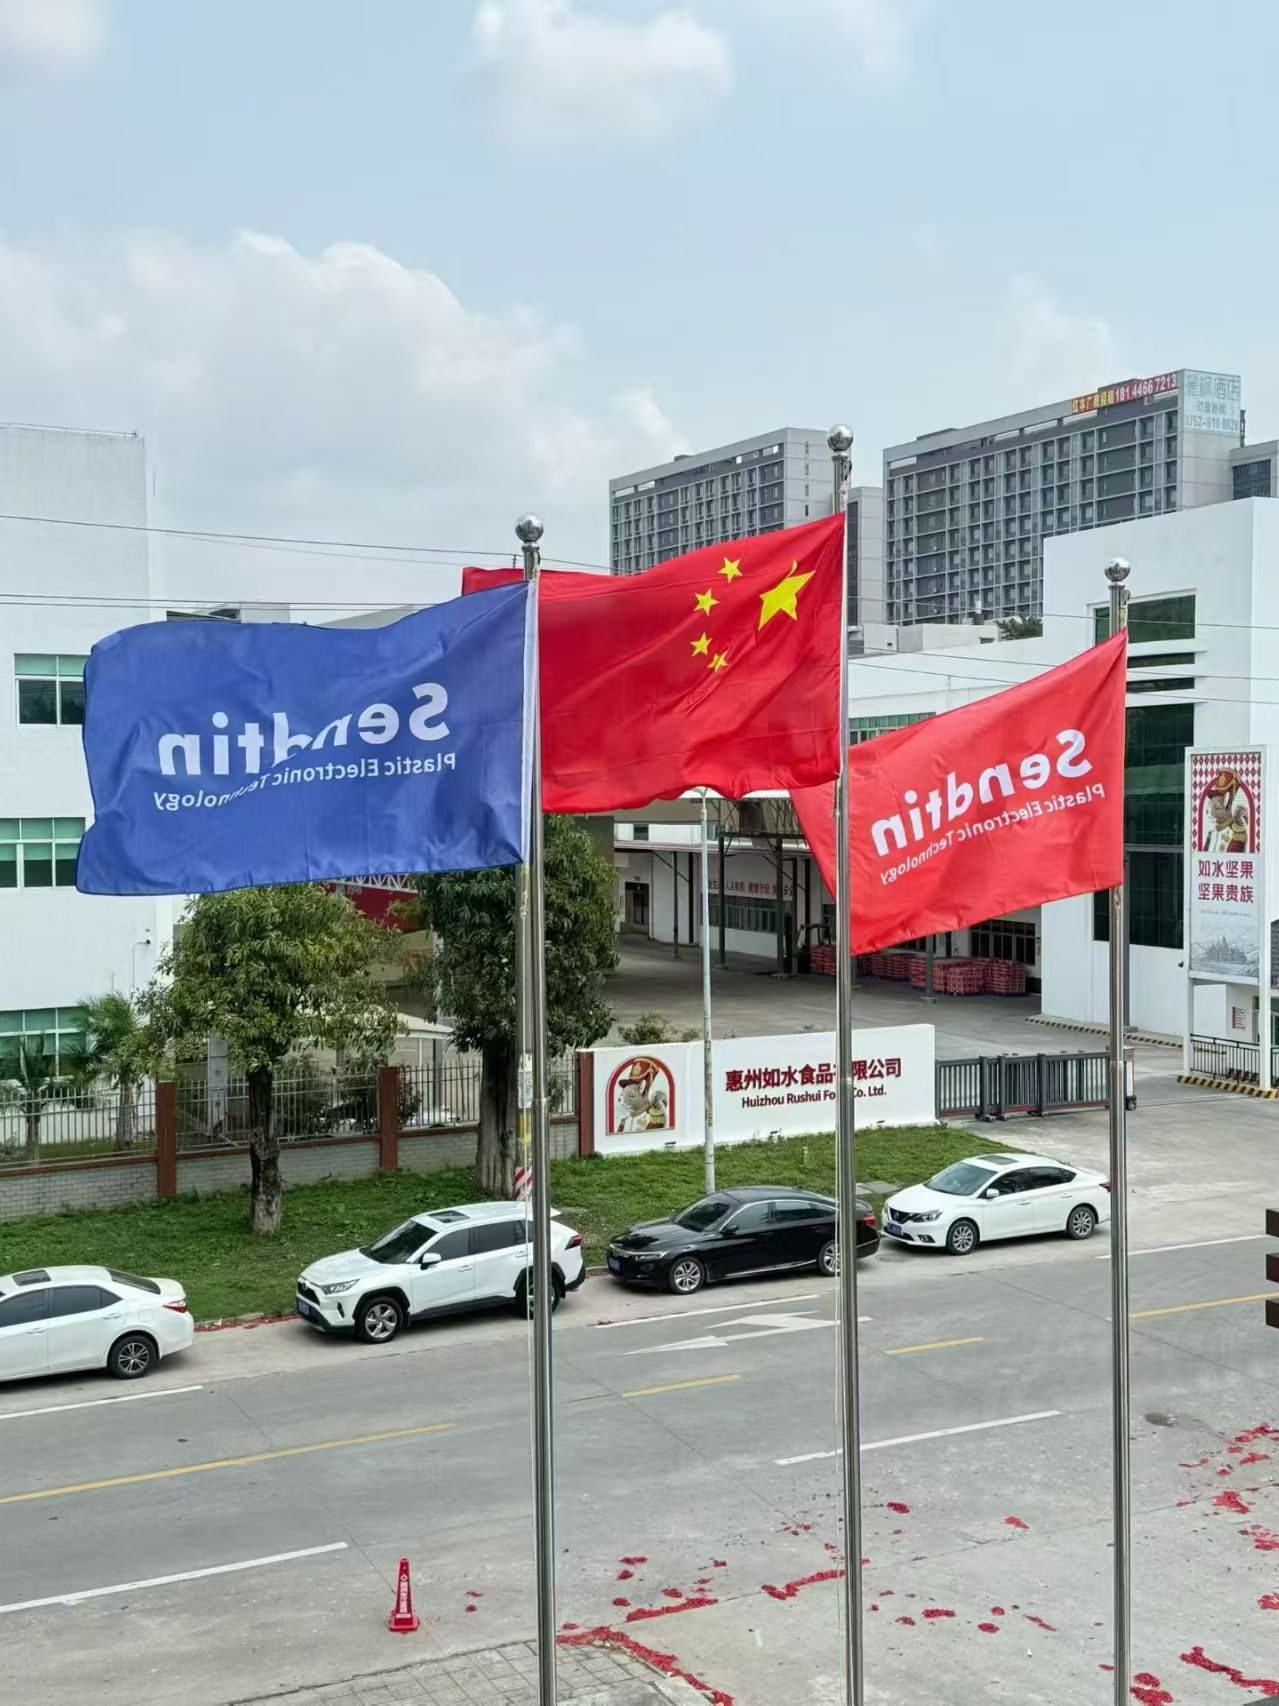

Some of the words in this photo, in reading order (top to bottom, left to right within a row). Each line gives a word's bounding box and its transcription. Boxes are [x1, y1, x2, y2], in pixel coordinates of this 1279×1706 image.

[1116, 386, 1130, 402] 181
[1132, 379, 1153, 398] 4466
[1155, 373, 1177, 392] 7213
[1198, 859, 1255, 880] 如水坚果
[1198, 883, 1255, 904] 坚果贵族
[725, 1057, 902, 1092] 惠州如水食品限公司
[742, 1093, 785, 1109] Huizhou
[787, 1089, 821, 1105] Rushui
[868, 1083, 887, 1098] Ltd.
